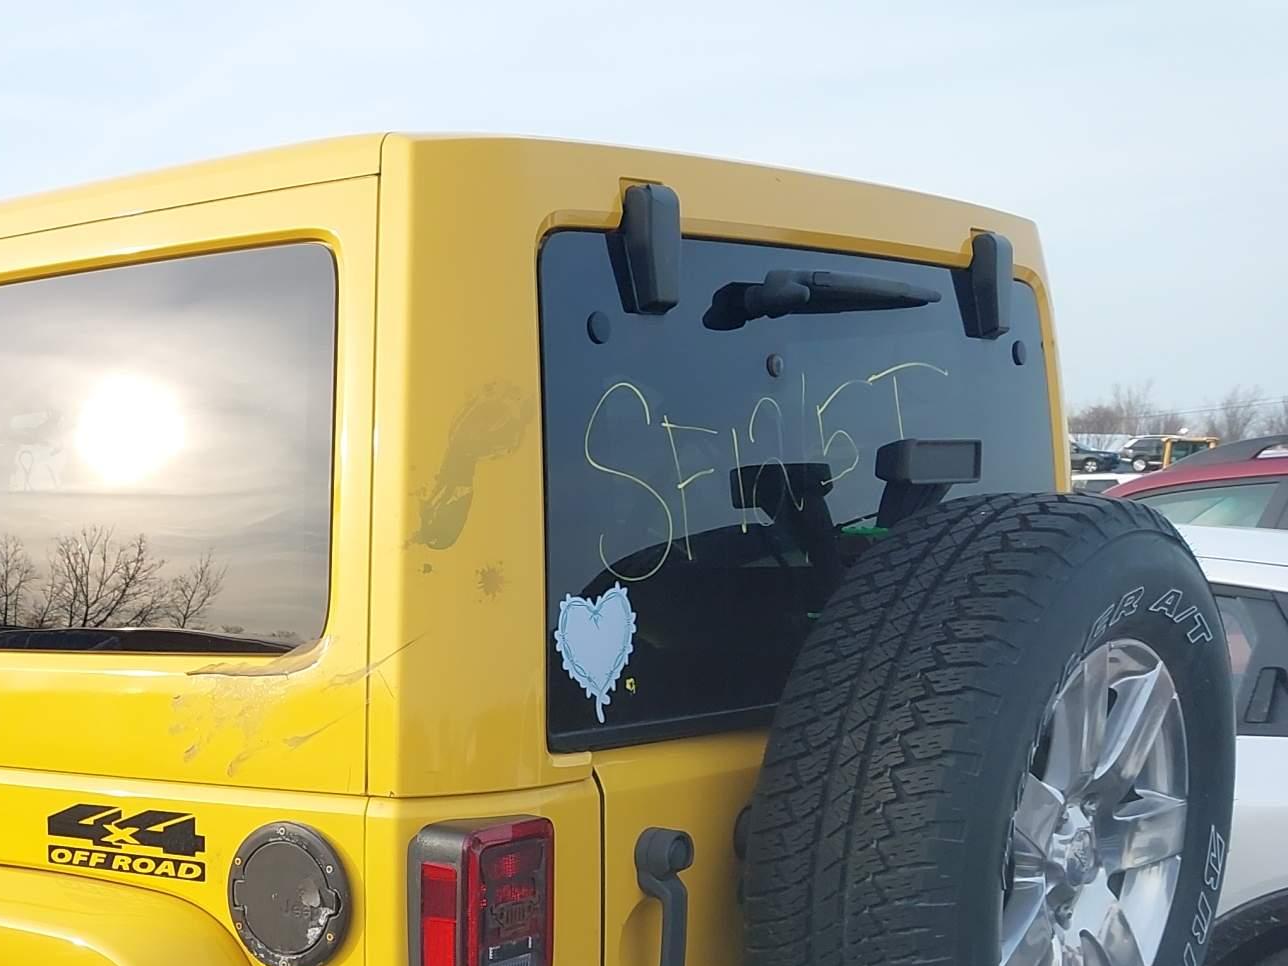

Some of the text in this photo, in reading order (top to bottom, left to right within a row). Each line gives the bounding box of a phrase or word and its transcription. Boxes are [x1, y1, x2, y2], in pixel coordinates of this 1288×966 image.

[1148, 588, 1213, 645] A/T
[50, 848, 203, 880] OFF ROAD
